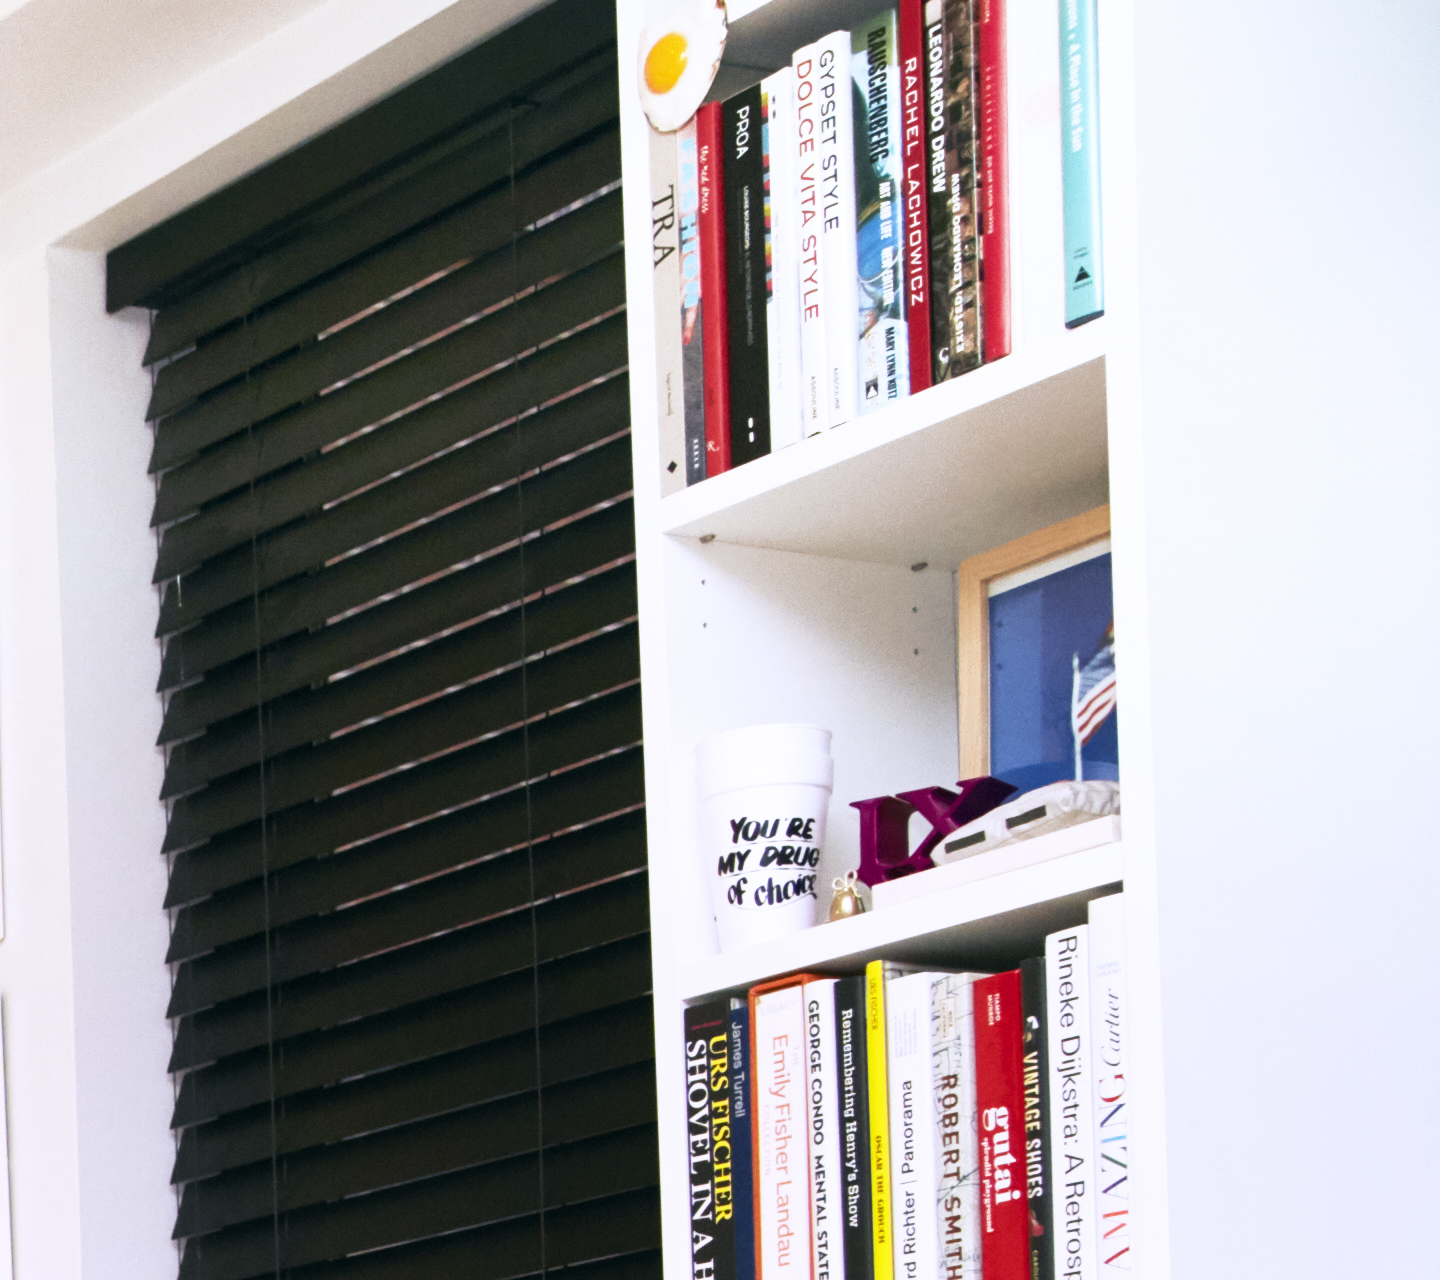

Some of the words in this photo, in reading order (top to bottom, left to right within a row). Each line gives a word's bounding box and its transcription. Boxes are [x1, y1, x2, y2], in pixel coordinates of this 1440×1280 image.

[797, 59, 815, 157] DOLCE
[820, 50, 836, 145] GYPSET
[867, 26, 889, 165] RAUSCHENBERG
[905, 57, 919, 156] RACHEL
[929, 23, 944, 131] LEONARDO
[735, 105, 751, 160] PROA
[931, 135, 946, 193] DREW
[652, 184, 676, 270] TRA
[800, 163, 816, 228] VITA
[822, 153, 839, 234] STYLE
[906, 164, 923, 307] LACHOWICZ
[802, 234, 819, 323] STYLE
[884, 326, 895, 351] MARY
[886, 353, 897, 378] LYNN
[717, 848, 750, 878] MY
[759, 844, 820, 869] DRUG
[730, 815, 816, 845] YOU'RE
[726, 877, 748, 907] of
[754, 872, 818, 906] choice
[1058, 935, 1080, 1028] Rineke
[709, 1031, 728, 1093] URS
[772, 1034, 789, 1099] Emily
[808, 1000, 822, 1074] GEORGE
[841, 1008, 855, 1119] Remembering
[686, 1040, 711, 1175] SHOVEL
[811, 1078, 825, 1146] CONDO
[901, 1080, 914, 1175] Panorama
[1023, 1051, 1041, 1131] VINTAGE
[1056, 1035, 1082, 1146] Dijkstra:
[711, 1099, 734, 1225] FISCHER
[775, 1103, 792, 1175] Fisher
[844, 1121, 858, 1181] Henry's
[941, 1074, 960, 1182] ROBERT
[982, 1106, 1022, 1206] gutai
[1064, 1153, 1085, 1175] A
[692, 1184, 713, 1224] IN
[814, 1154, 828, 1228] MENTAL
[847, 1182, 860, 1228] Show
[1025, 1138, 1044, 1200] SHOES
[693, 1231, 714, 1256] A
[777, 1181, 794, 1268] Landau
[903, 1191, 917, 1255] Richter
